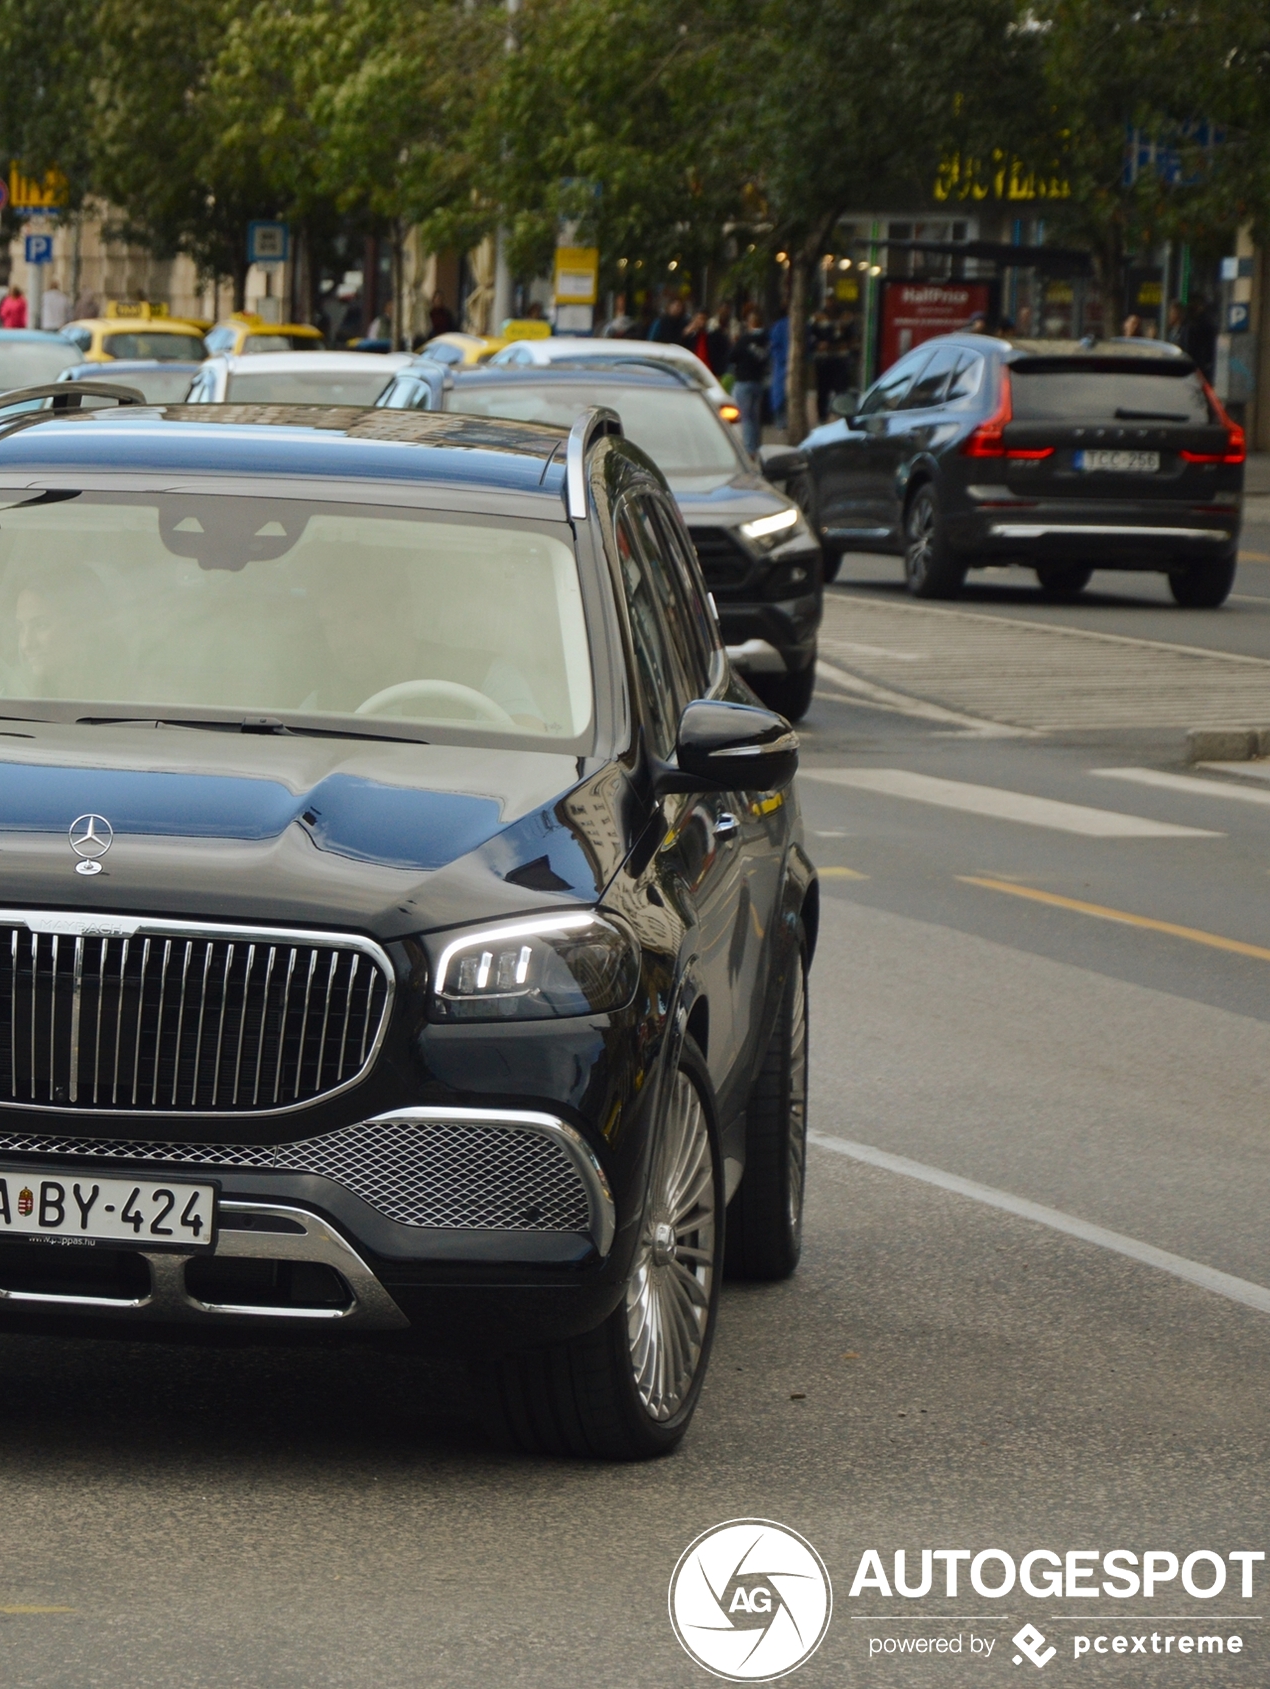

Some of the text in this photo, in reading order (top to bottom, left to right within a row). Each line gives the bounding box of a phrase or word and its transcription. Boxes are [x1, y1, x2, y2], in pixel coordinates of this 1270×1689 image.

[31, 238, 47, 260] P
[902, 287, 969, 303] HalfPrice
[1232, 305, 1247, 326] P
[40, 919, 124, 935] MAYBACH
